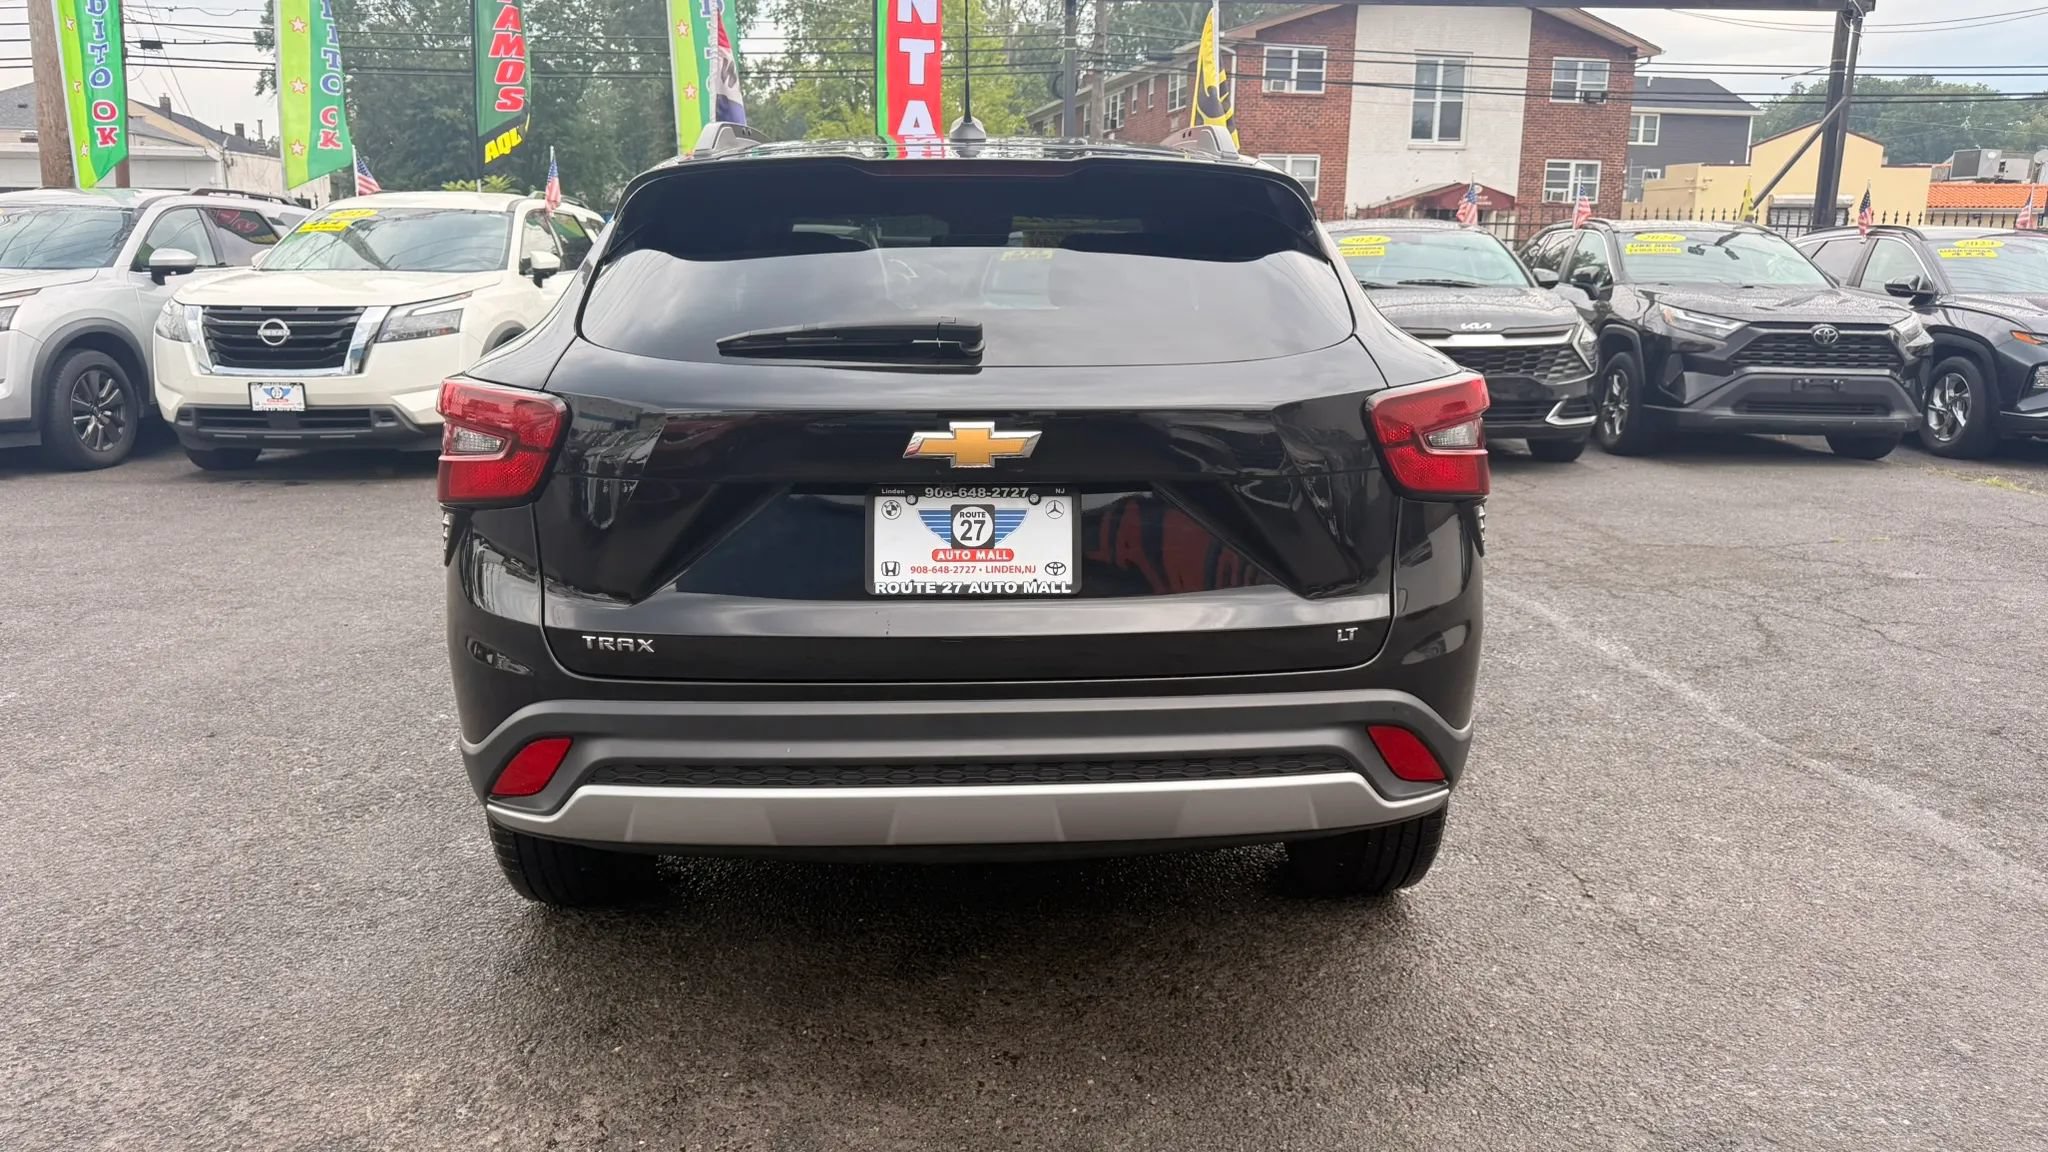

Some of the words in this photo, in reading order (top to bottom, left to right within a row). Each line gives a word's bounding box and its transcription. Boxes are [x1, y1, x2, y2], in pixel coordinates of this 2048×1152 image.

[488, 0, 526, 112] AMOS
[92, 100, 118, 147] OK
[881, 487, 906, 495] Linden
[959, 511, 987, 519] ROUTE
[960, 519, 986, 542] 27
[937, 550, 971, 560] AUTO
[975, 550, 1009, 560] MALL
[910, 565, 977, 574] 908-648-2727
[985, 565, 1037, 575] LINDEN,NJ
[874, 581, 937, 594] ROUTE
[941, 581, 963, 594] 27
[967, 581, 1018, 594] AUTO
[1023, 581, 1072, 594] MALL
[1336, 627, 1359, 643] LT
[581, 635, 655, 653] TRAX
